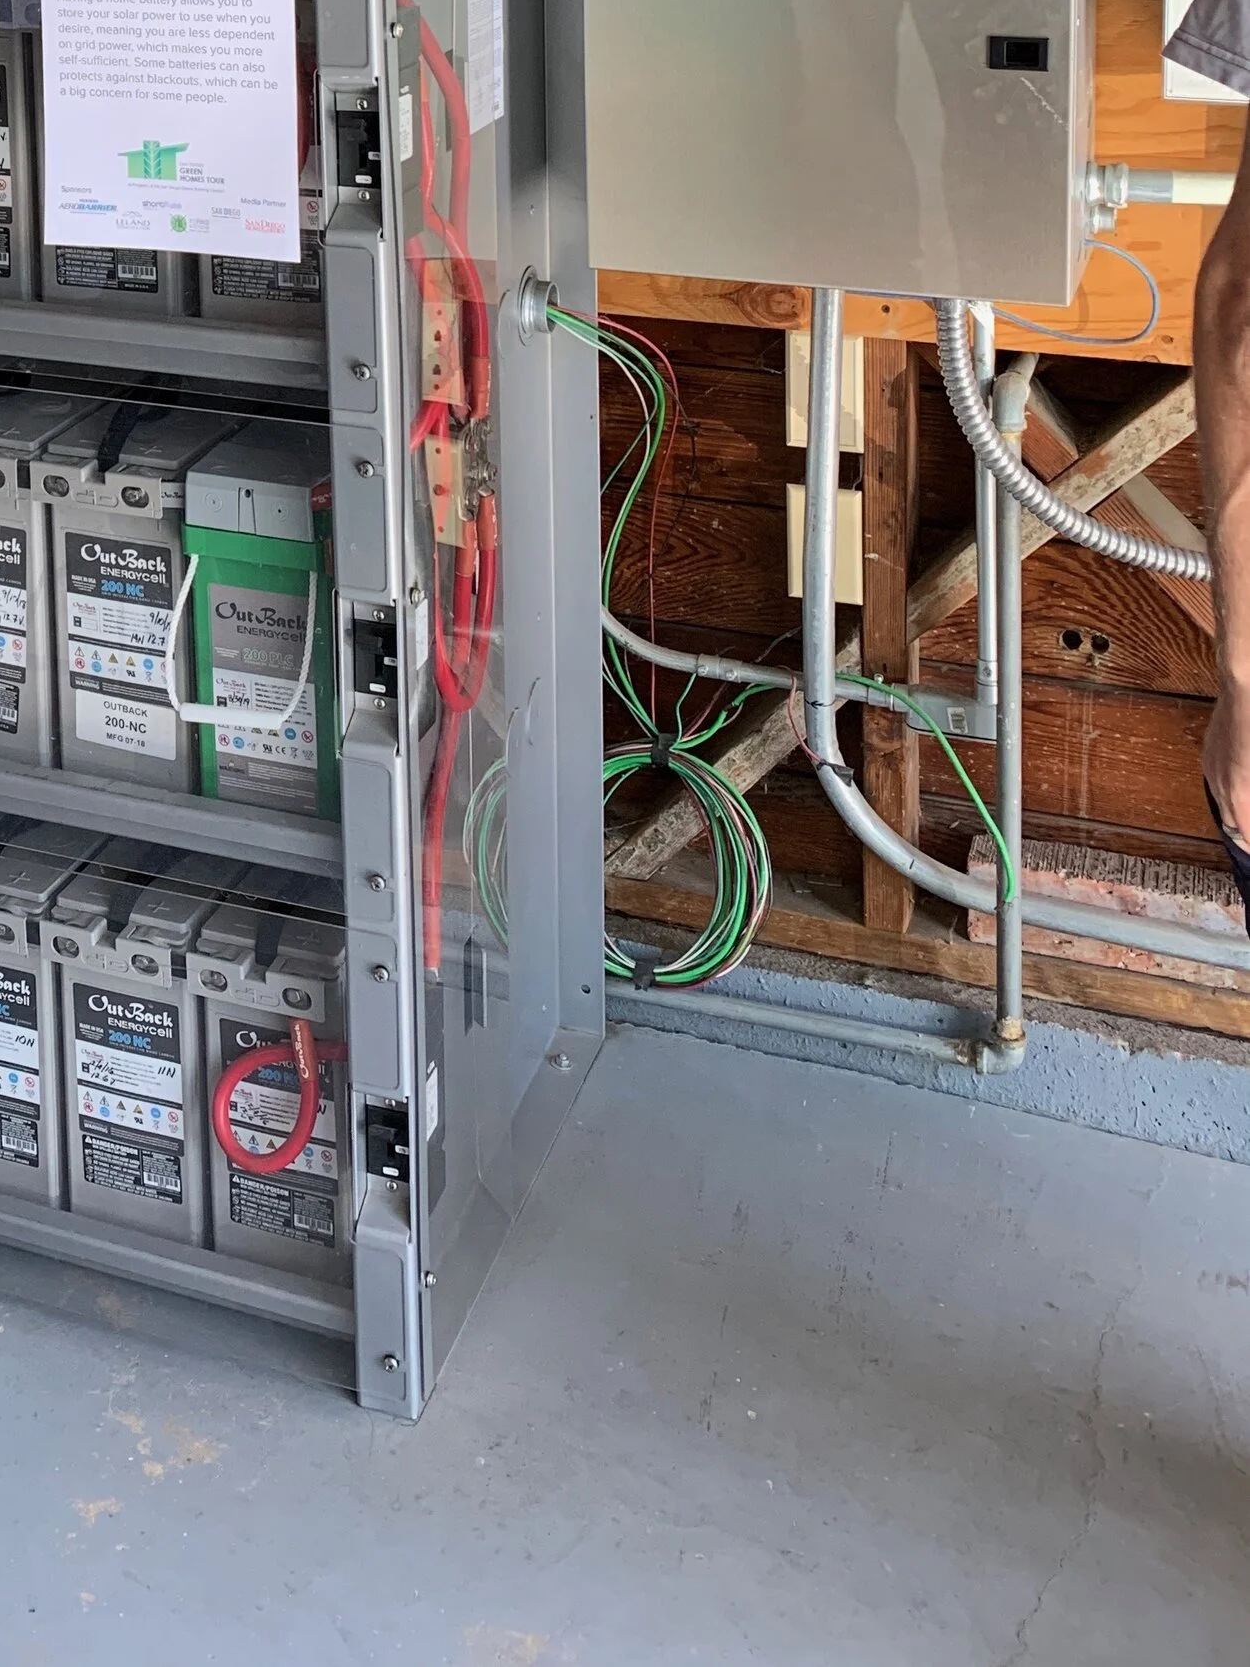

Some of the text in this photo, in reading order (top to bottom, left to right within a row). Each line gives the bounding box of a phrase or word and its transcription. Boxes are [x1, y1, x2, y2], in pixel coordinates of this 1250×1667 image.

[57, 8, 271, 26] store your solar power to use when you
[58, 23, 276, 43] desire, meaning you are less dependent
[58, 39, 263, 57] on grid power, which makes you more
[59, 55, 265, 73] self-sufficient. Some batteries can also
[59, 71, 279, 90] protects against blackouts, which can be
[60, 86, 227, 105] a big concern for some people.
[179, 167, 203, 175] GREEN
[179, 175, 225, 184] HOMES TOUR
[61, 185, 92, 194] Sponsors
[240, 197, 287, 208] Media Partner
[80, 543, 167, 573] OutBack
[100, 566, 166, 584] ENERGYcell
[101, 580, 145, 597] 200 NC
[243, 648, 294, 667] 200 PLC
[103, 700, 148, 717] OUTBACK
[104, 715, 147, 734] 200-NC
[106, 732, 146, 748] MFG 07-18
[88, 994, 173, 1028] OutBack
[107, 1017, 173, 1039] ENERGYcell
[108, 1029, 151, 1050] 200 NC
[294, 1023, 310, 1079] OutBack
